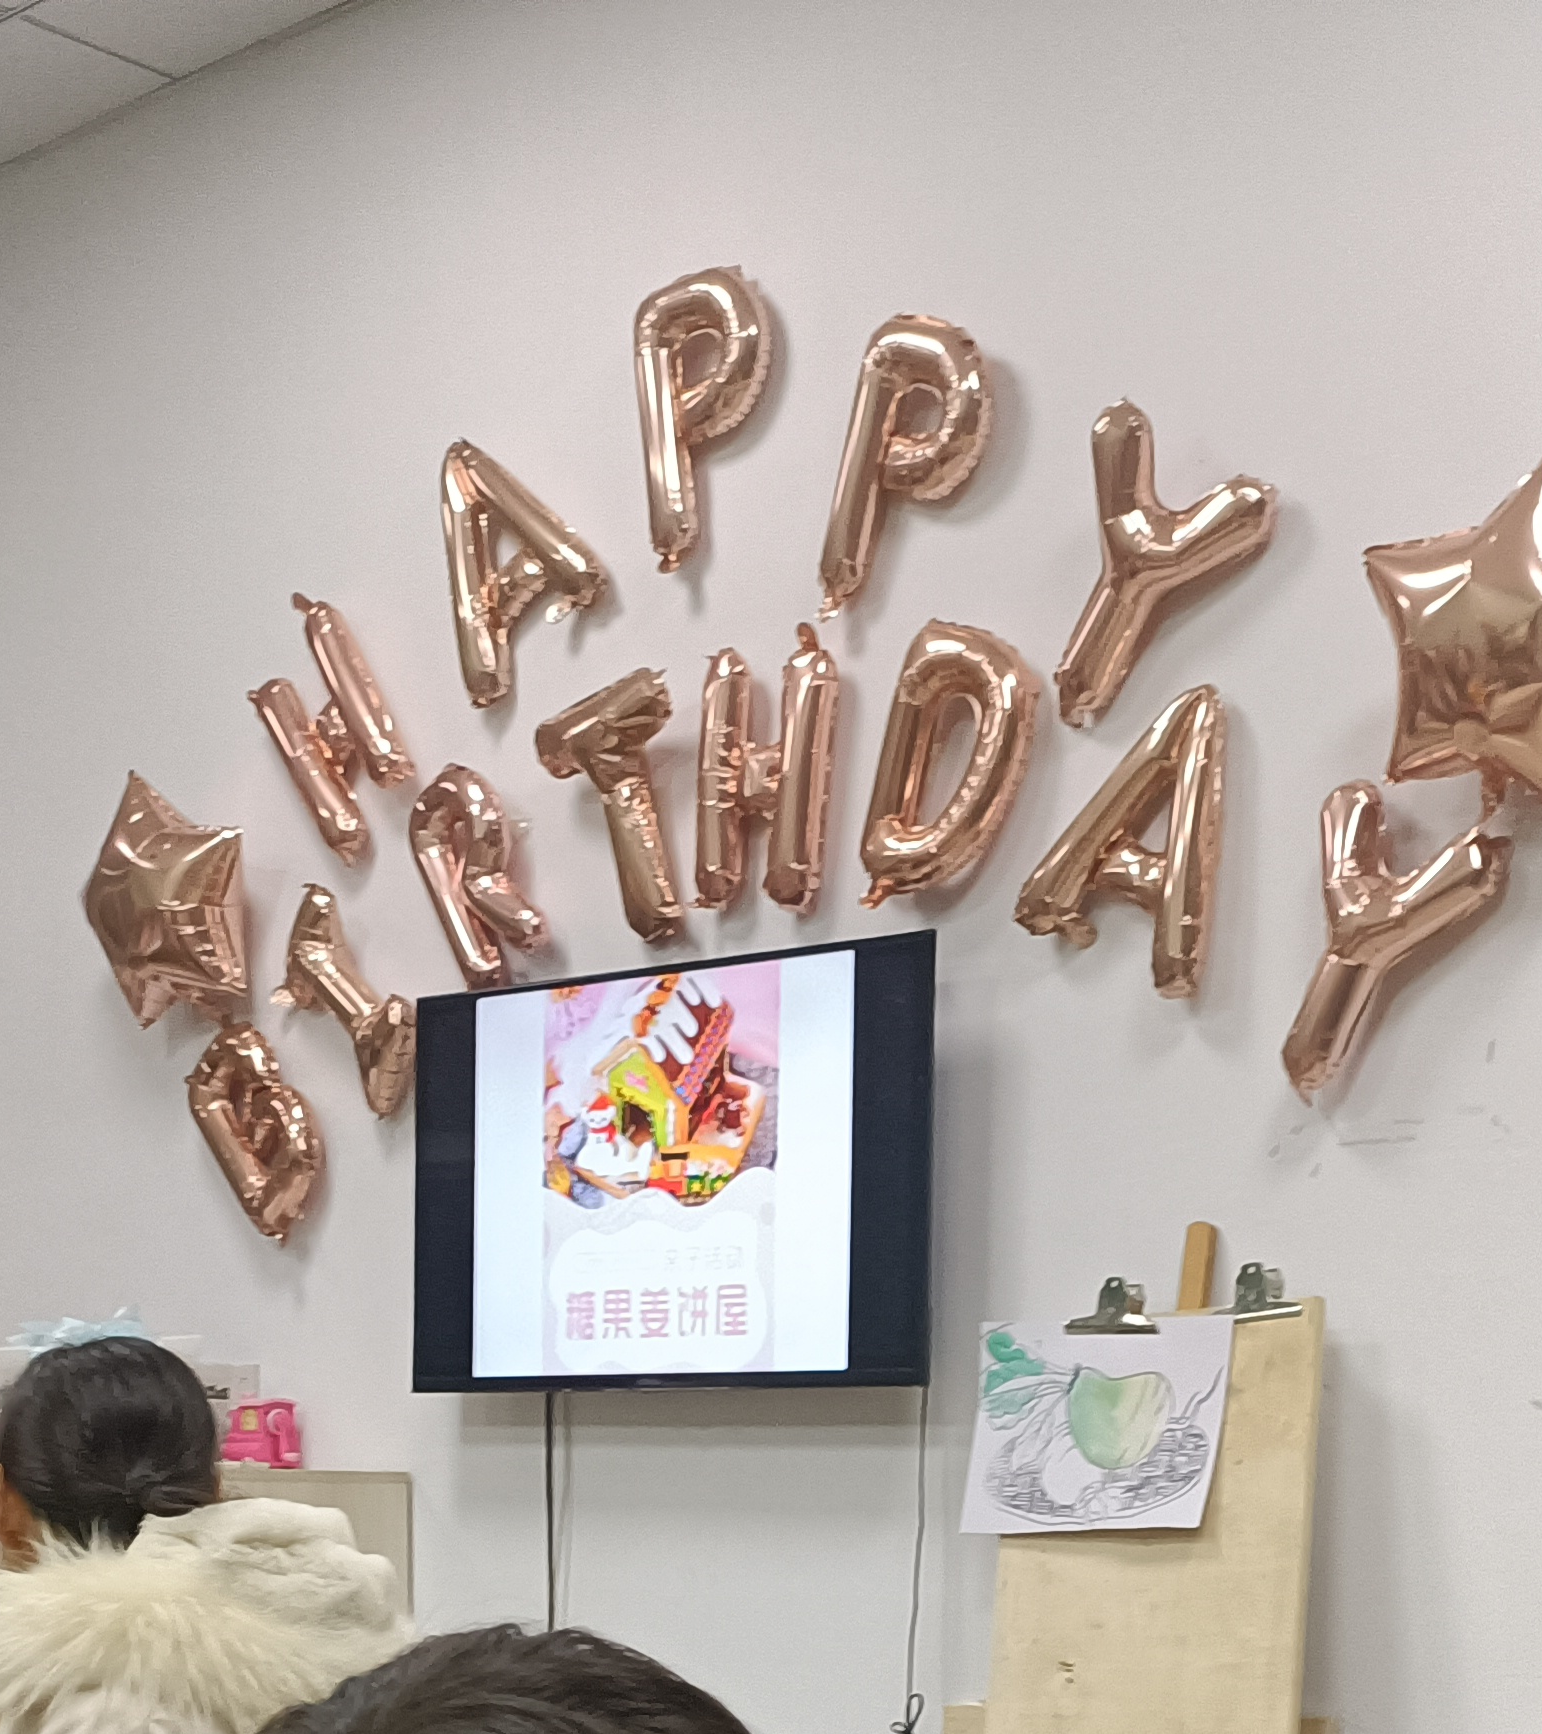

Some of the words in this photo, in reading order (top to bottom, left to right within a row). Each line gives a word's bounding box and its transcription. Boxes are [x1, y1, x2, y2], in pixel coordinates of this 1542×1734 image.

[247, 264, 1277, 867] HAPPY
[187, 621, 1512, 1243] BIRTHDAY
[565, 1284, 749, 1341] 糖果姜饼屋
